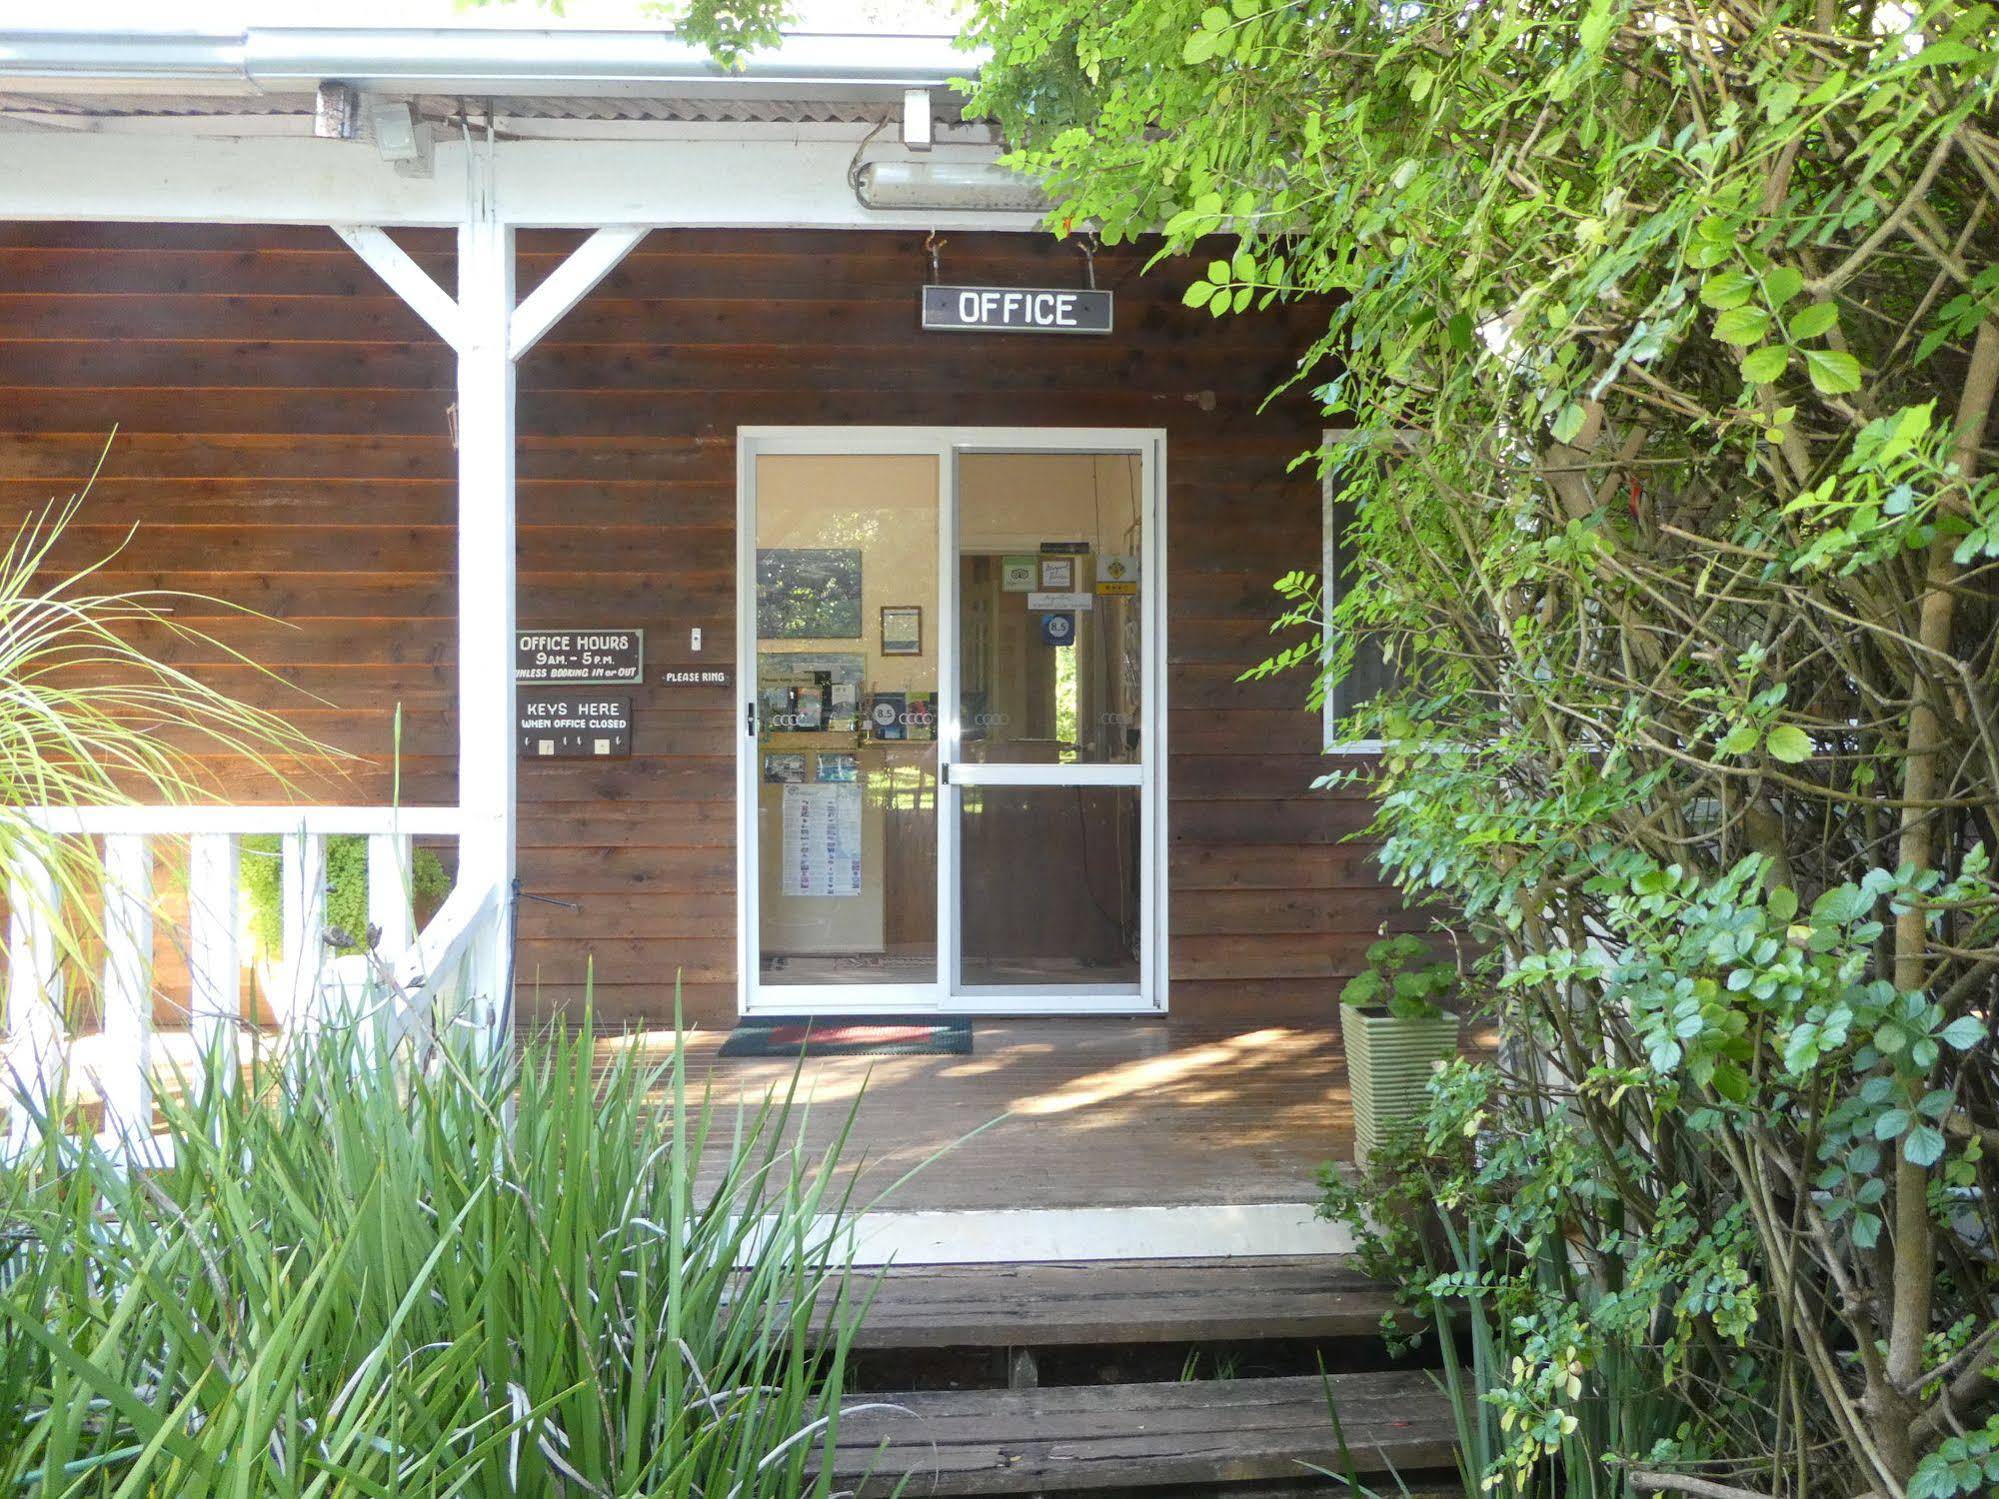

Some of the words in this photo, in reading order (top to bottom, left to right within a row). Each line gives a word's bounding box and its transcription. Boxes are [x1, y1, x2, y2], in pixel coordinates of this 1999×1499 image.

[958, 291, 1078, 326] OFFICE
[519, 636, 571, 651] OFFICE
[577, 636, 629, 651] HOURS
[550, 668, 589, 678] BOOKING
[592, 668, 604, 677] IN
[605, 669, 617, 677] or
[617, 667, 637, 677] OUT
[666, 672, 700, 682] PLEASE
[702, 672, 725, 682] RING
[527, 702, 568, 716] KEYS
[578, 703, 620, 716] HERE
[521, 719, 552, 729] WHEN
[553, 719, 586, 729] OFFICE
[589, 719, 627, 729] CLOSED
